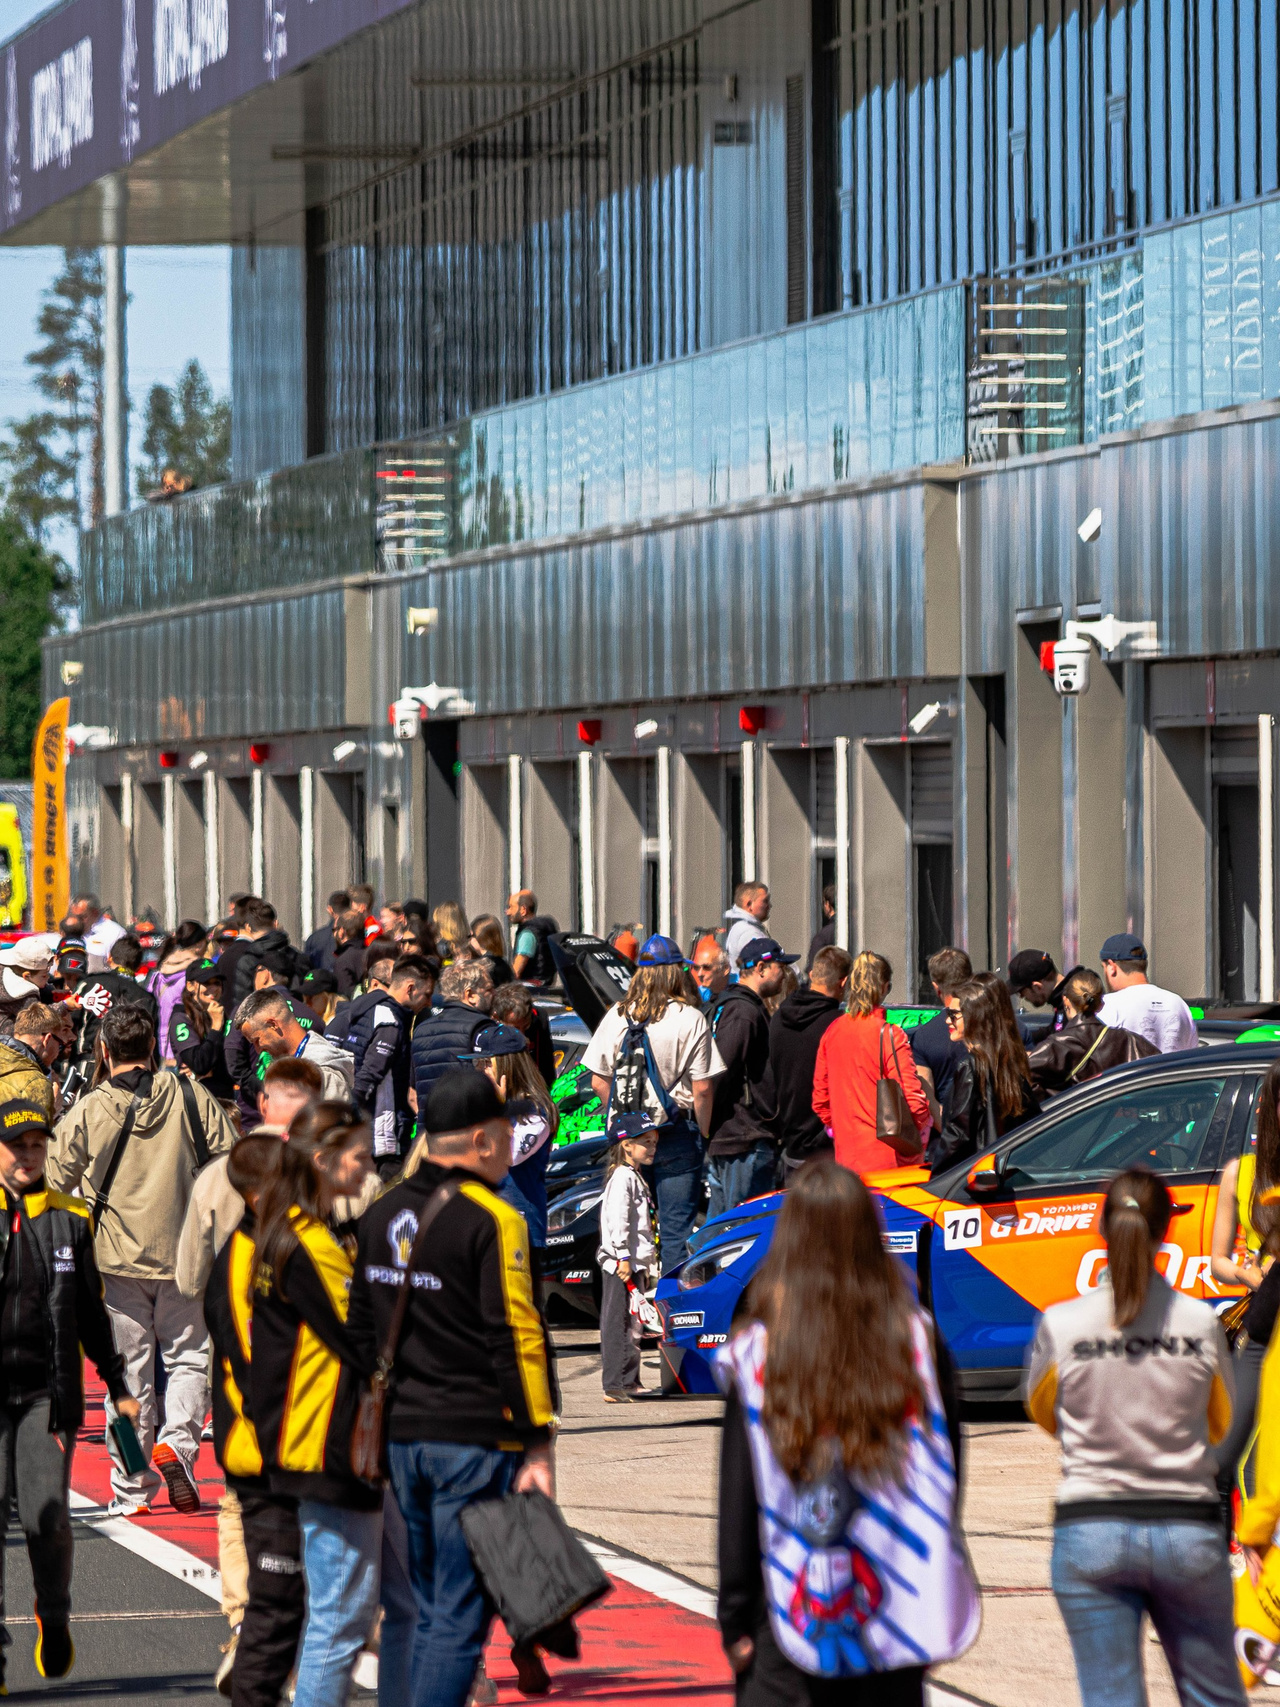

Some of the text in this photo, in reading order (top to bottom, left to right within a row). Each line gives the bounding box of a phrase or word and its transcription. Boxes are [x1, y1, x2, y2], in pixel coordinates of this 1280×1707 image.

[176, 1023, 190, 1042] 5
[1042, 1202, 1097, 1215] ТОПЛИВО
[946, 1217, 980, 1240] 10
[565, 1271, 590, 1279] АВТО
[699, 1334, 727, 1344] АВТО
